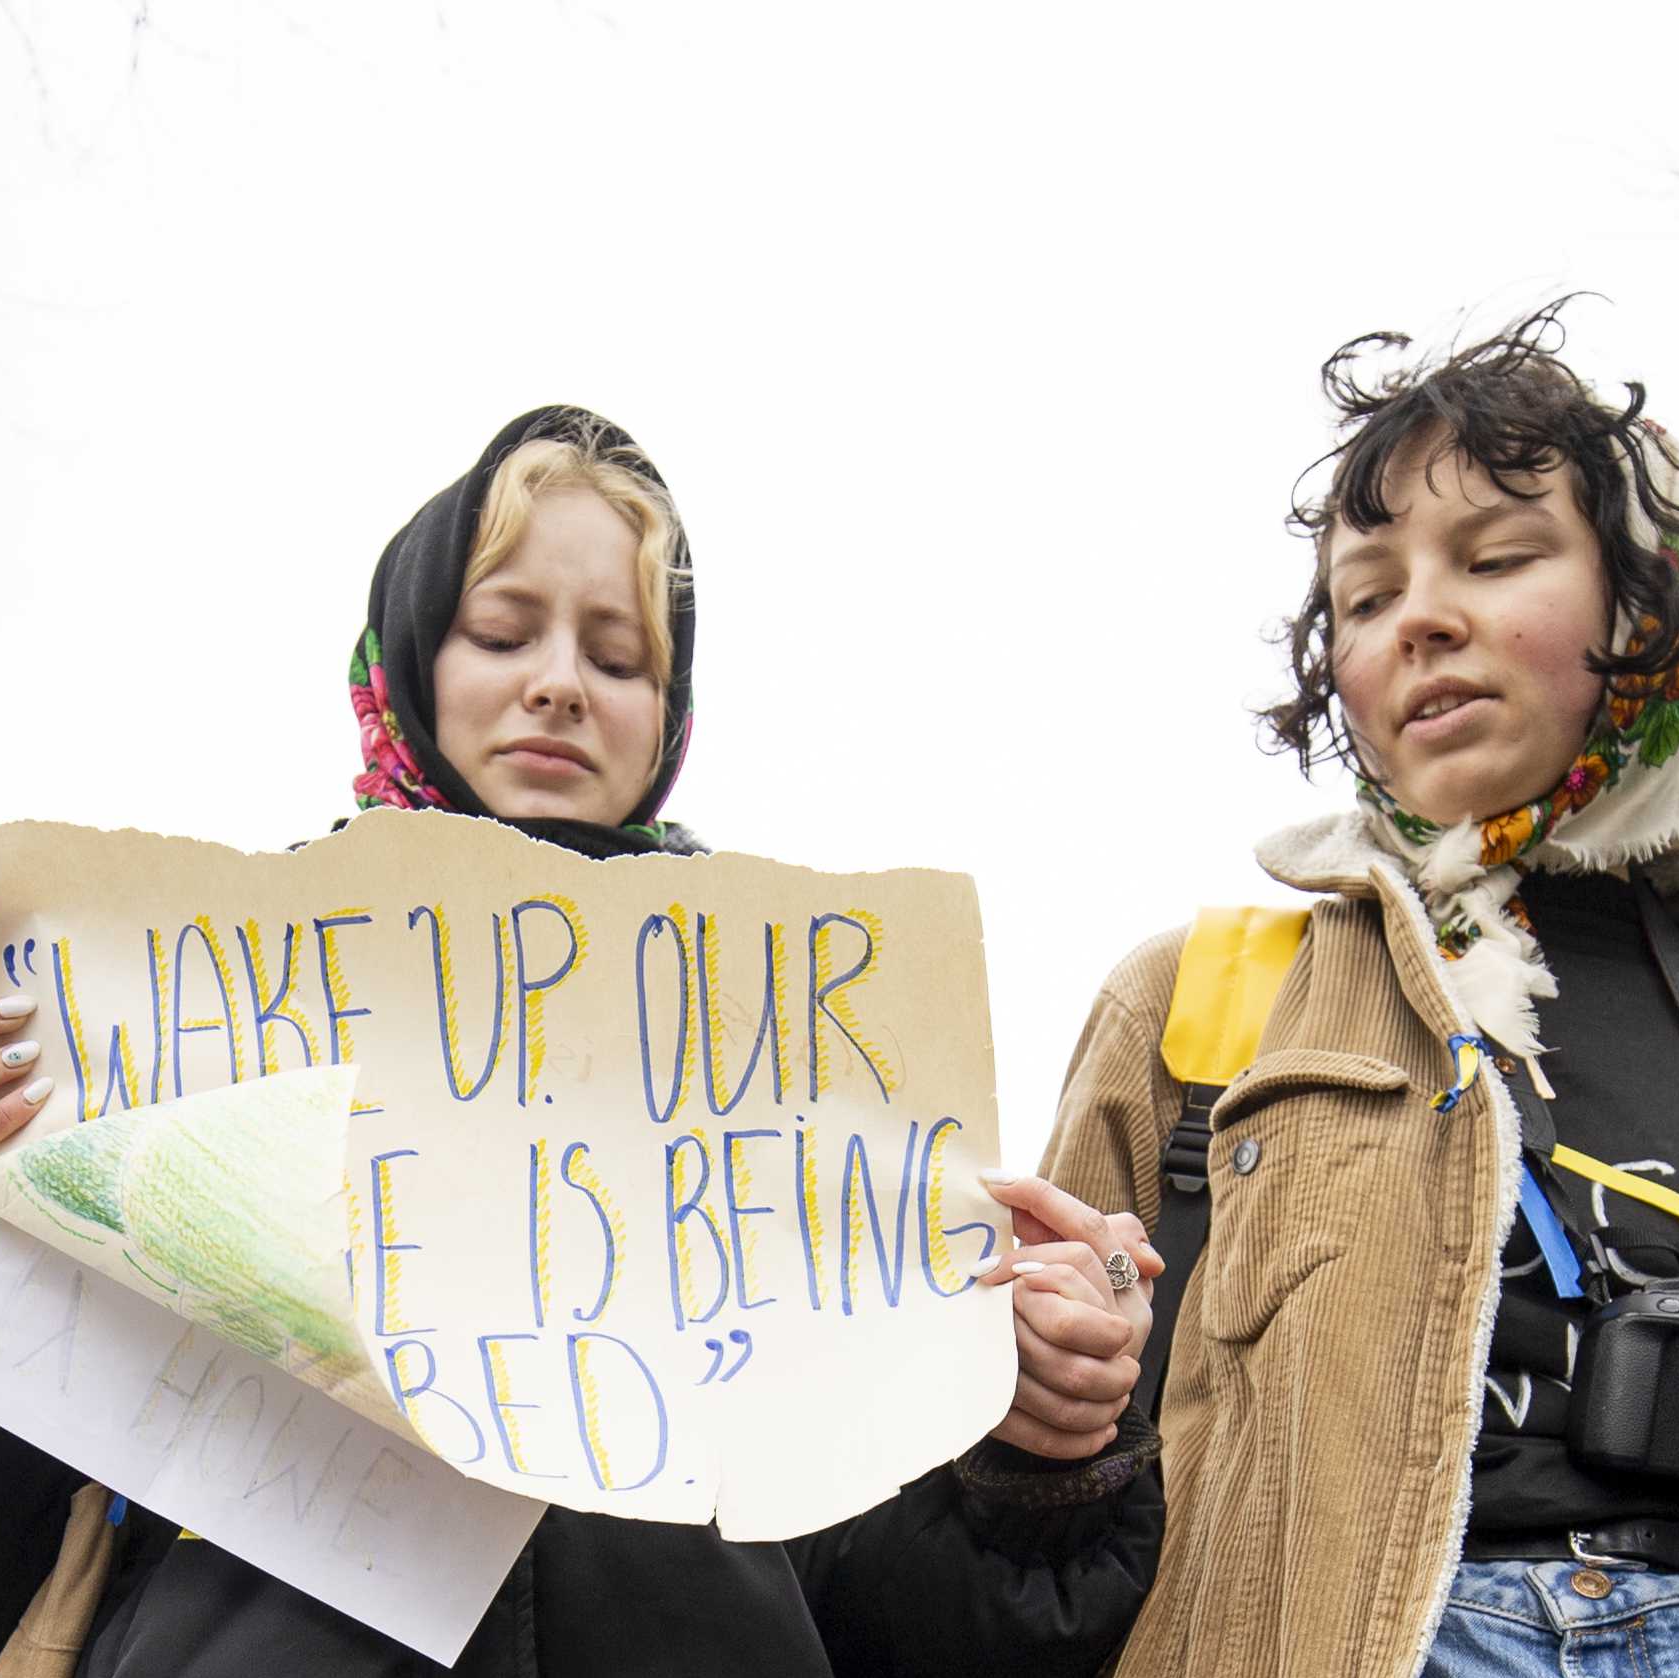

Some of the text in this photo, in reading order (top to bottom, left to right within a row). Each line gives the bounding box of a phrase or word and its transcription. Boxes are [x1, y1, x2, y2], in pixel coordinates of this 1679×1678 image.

[409, 893, 590, 1107] UP.
[636, 902, 901, 1124] OUR
[529, 1138, 627, 1328] IS
